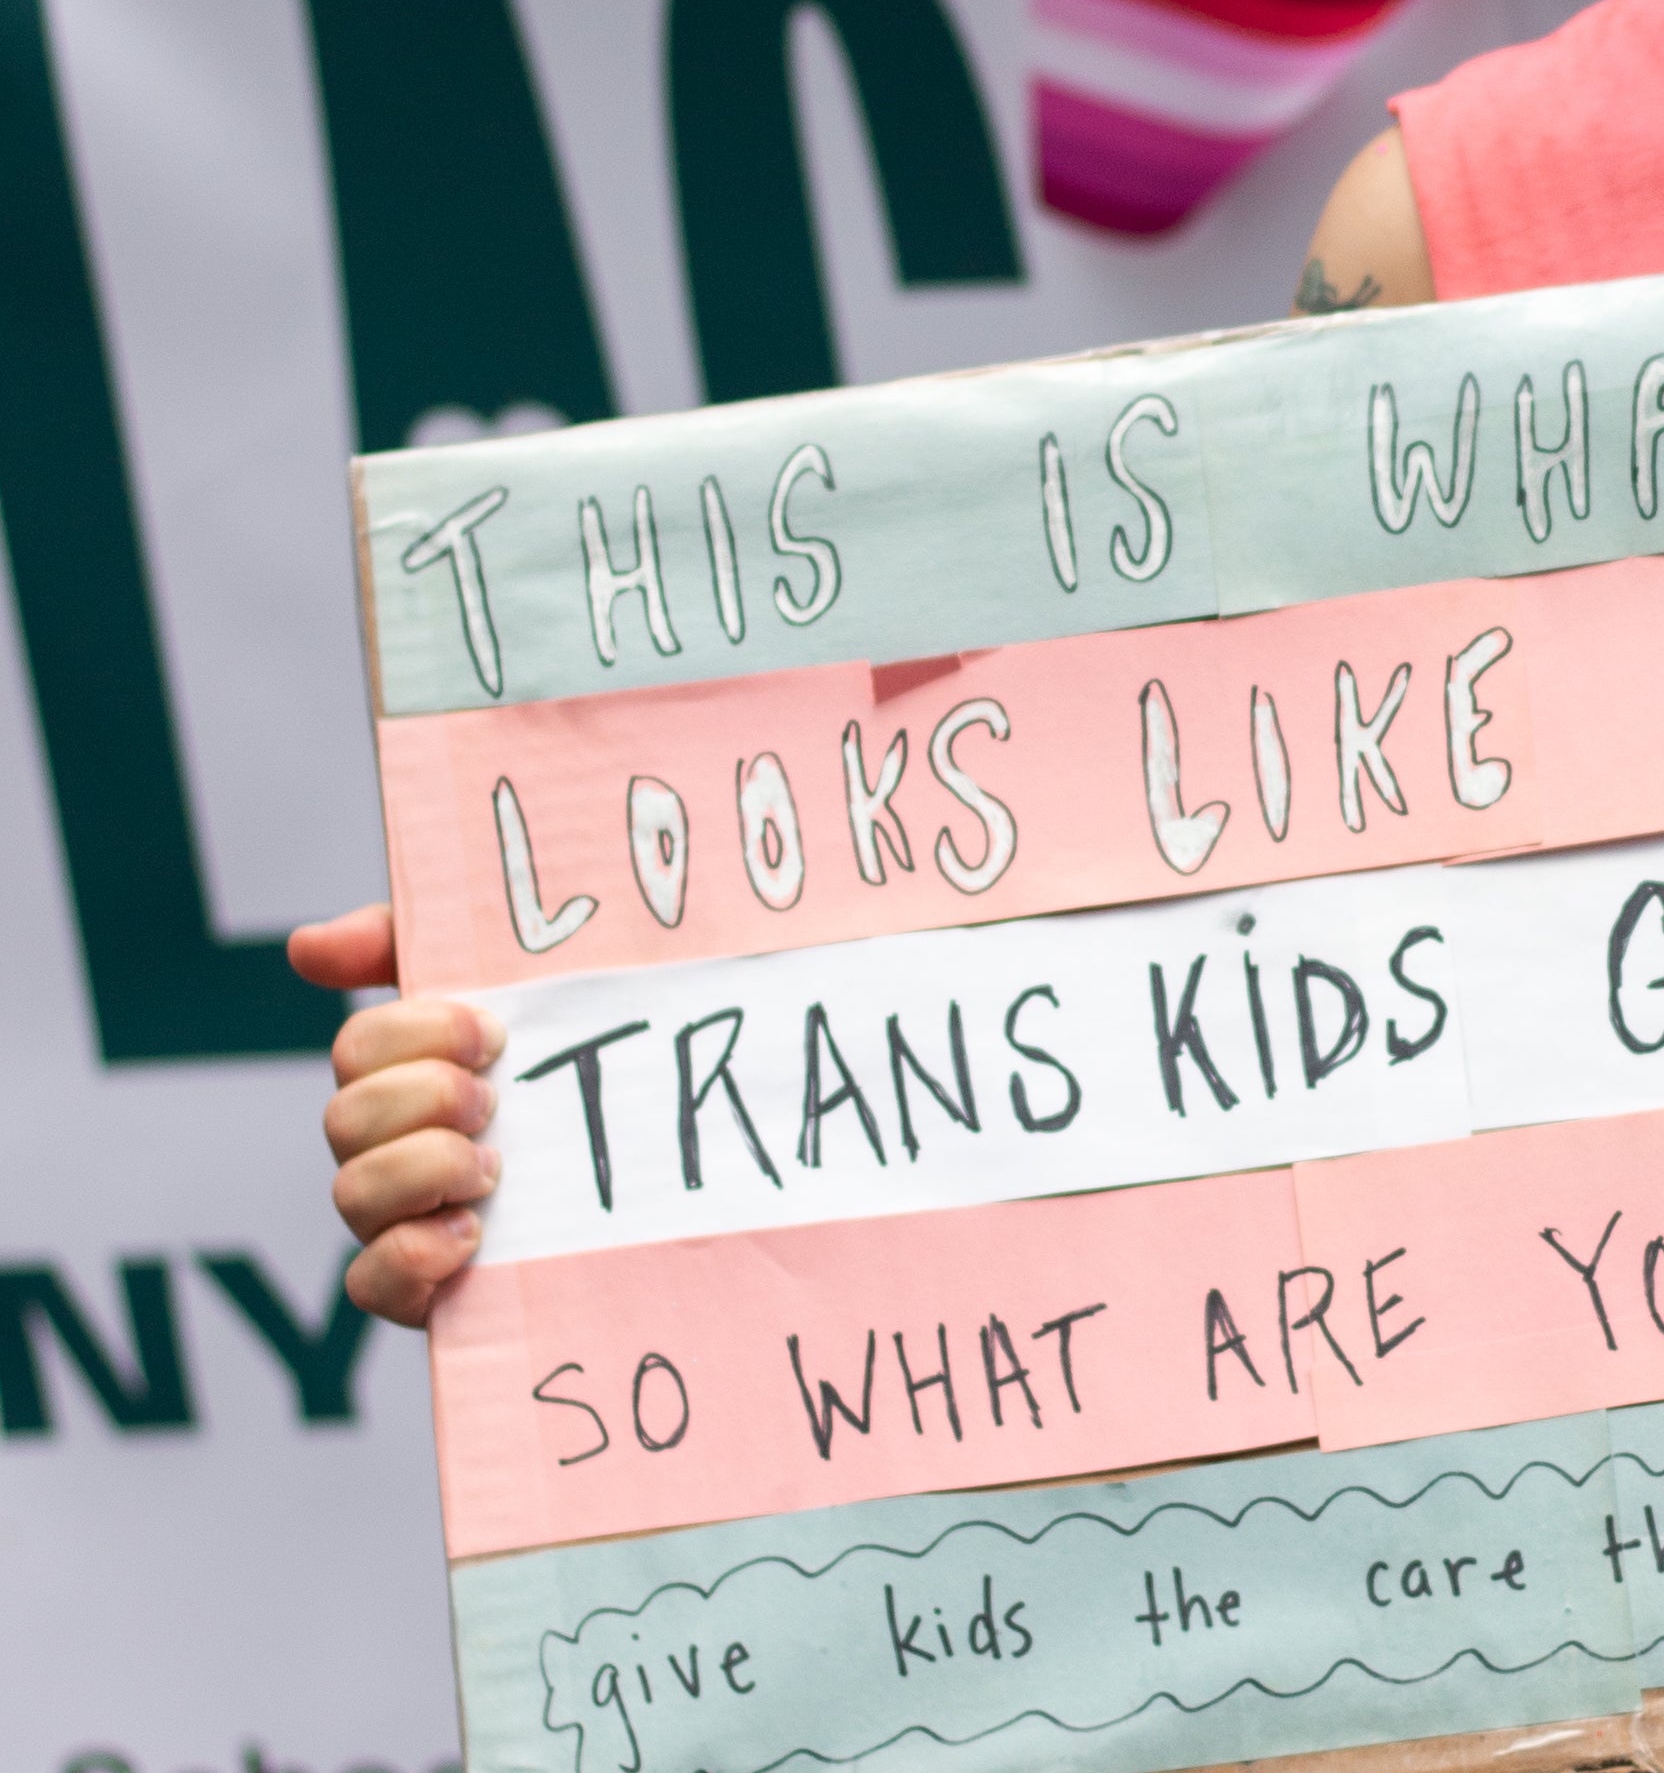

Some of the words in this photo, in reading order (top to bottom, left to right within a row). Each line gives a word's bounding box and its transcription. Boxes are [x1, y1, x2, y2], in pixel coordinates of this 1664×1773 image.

[402, 444, 841, 699] THIS
[1040, 394, 1178, 593] IS
[492, 698, 1017, 954] LOOKS
[1139, 627, 1513, 875] LIKE
[515, 985, 1082, 1212] TRANS
[531, 1352, 690, 1466] SO
[787, 1302, 1107, 1461] WHAT
[1205, 1247, 1427, 1401] ARE
[884, 1574, 1035, 1677] kids
[1134, 1566, 1243, 1647] the
[1366, 1545, 1529, 1607] care
